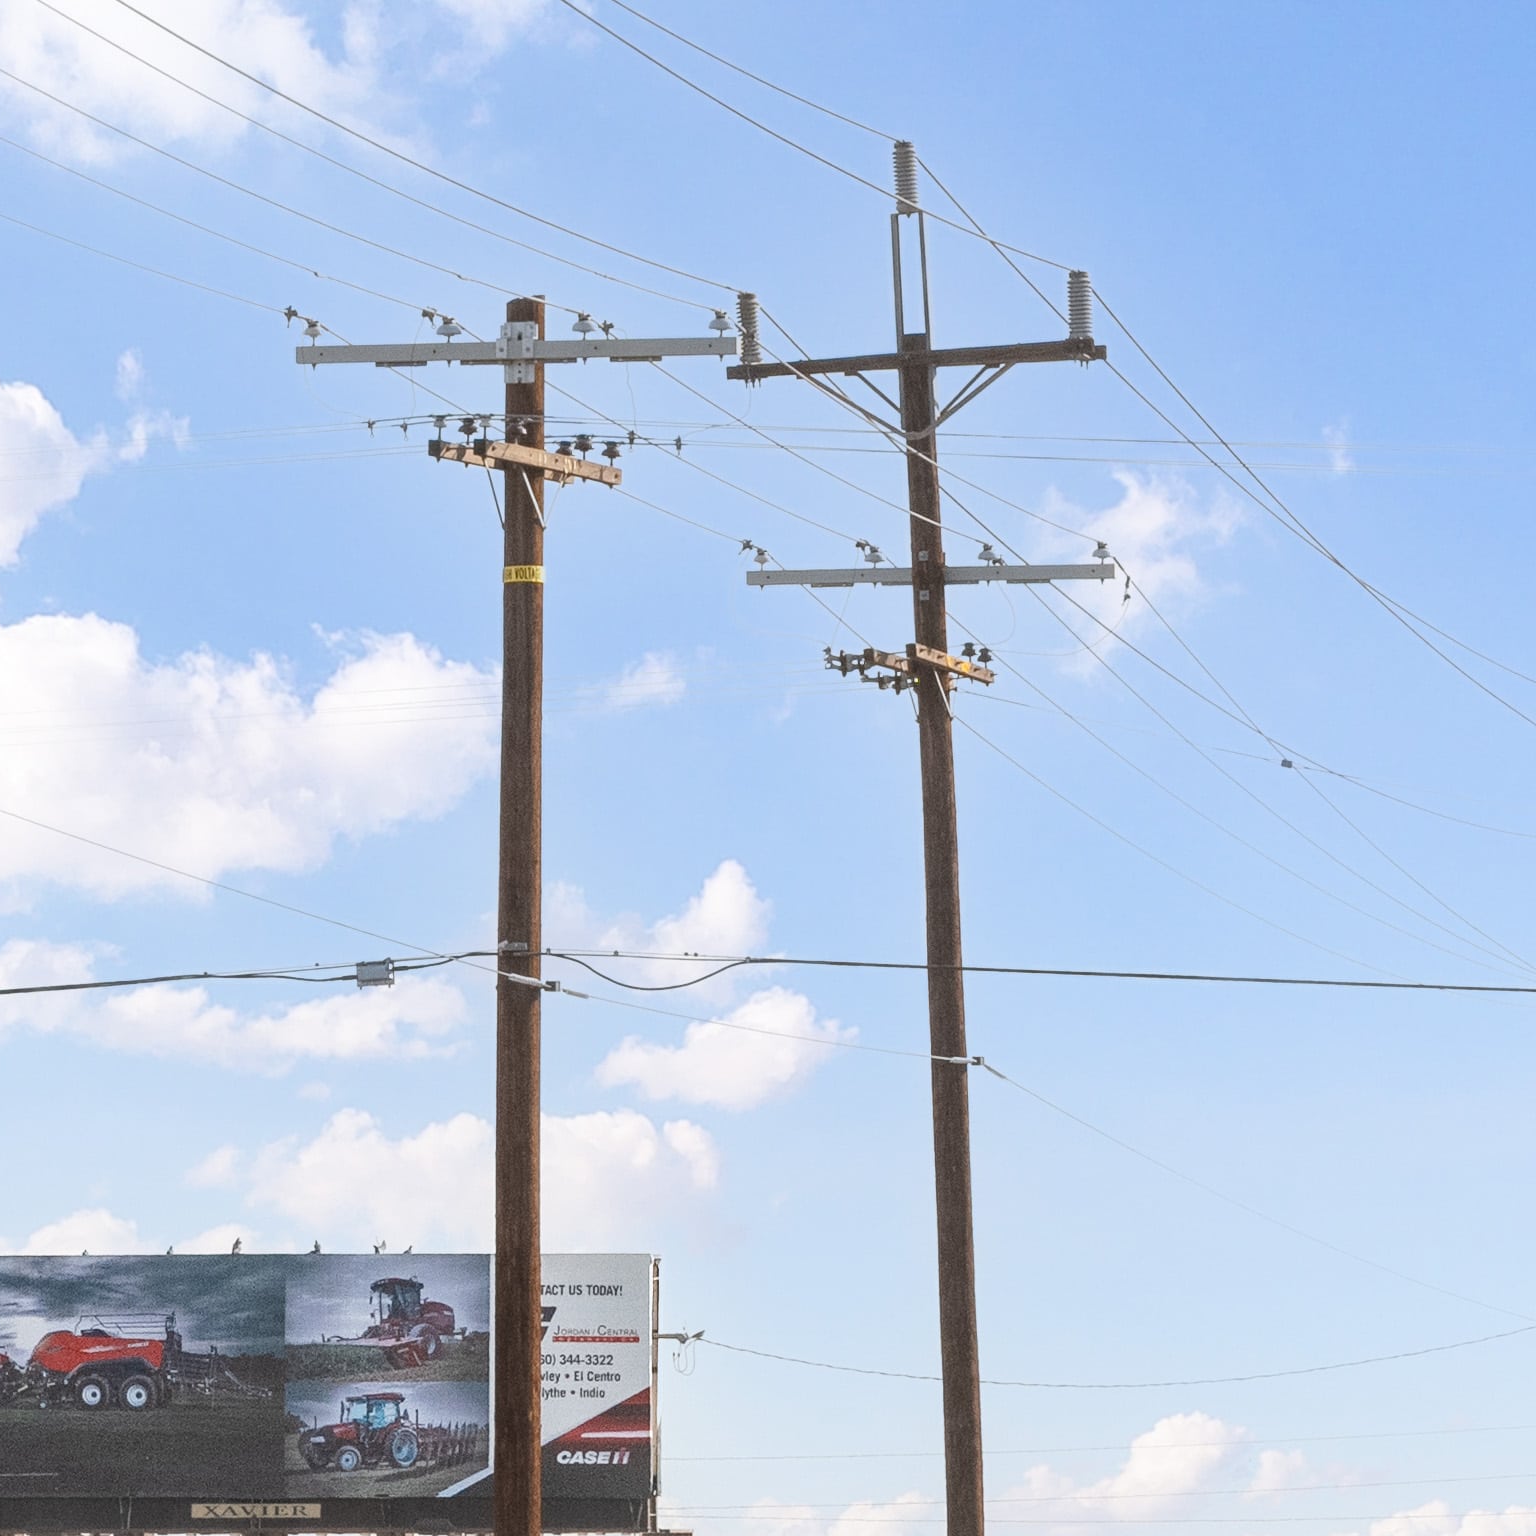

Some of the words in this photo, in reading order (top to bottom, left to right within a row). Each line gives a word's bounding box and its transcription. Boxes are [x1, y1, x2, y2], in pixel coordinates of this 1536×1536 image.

[541, 1285, 564, 1295] TACT
[569, 1285, 582, 1296] US
[587, 1285, 623, 1296] TODAY!
[597, 1325, 638, 1336] CENTRAL
[560, 1354, 614, 1366] 344-3322
[574, 1371, 583, 1381] El
[587, 1371, 621, 1382] Centro
[542, 1387, 566, 1400] lythe
[580, 1387, 605, 1399] Indio
[557, 1450, 610, 1464] CASE
[204, 1505, 307, 1517] XAVIER
